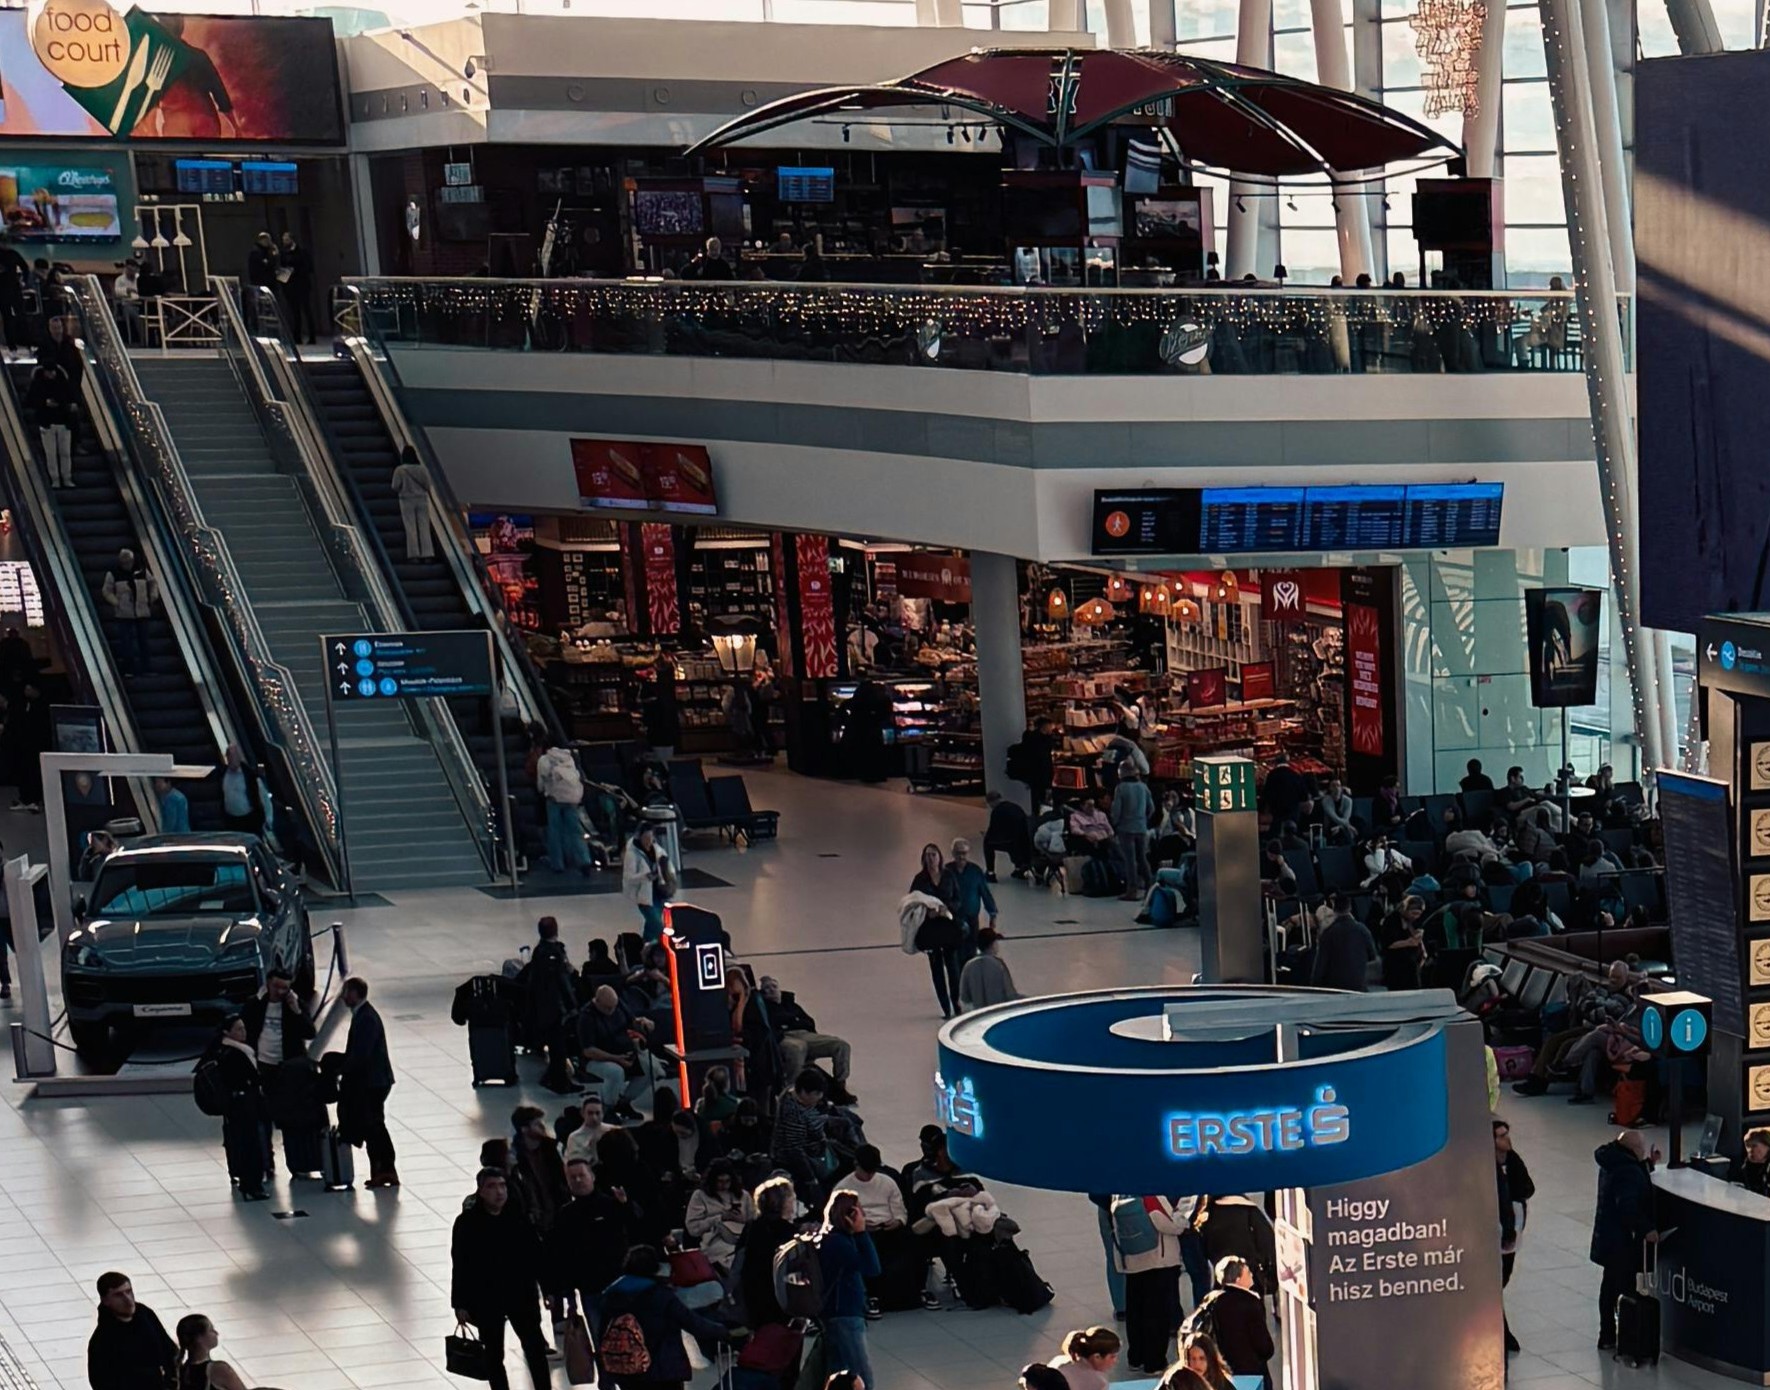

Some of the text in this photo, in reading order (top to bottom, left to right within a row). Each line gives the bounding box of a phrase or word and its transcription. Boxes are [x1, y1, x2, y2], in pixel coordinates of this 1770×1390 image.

[46, 7, 112, 32] food
[47, 39, 120, 62] court
[1169, 1112, 1305, 1156] ERSTE
[1326, 1198, 1390, 1221] Higgy
[1328, 1219, 1447, 1248] magadban!
[1329, 1244, 1464, 1274] Az Erste már
[1330, 1272, 1465, 1301] hisz benned.
